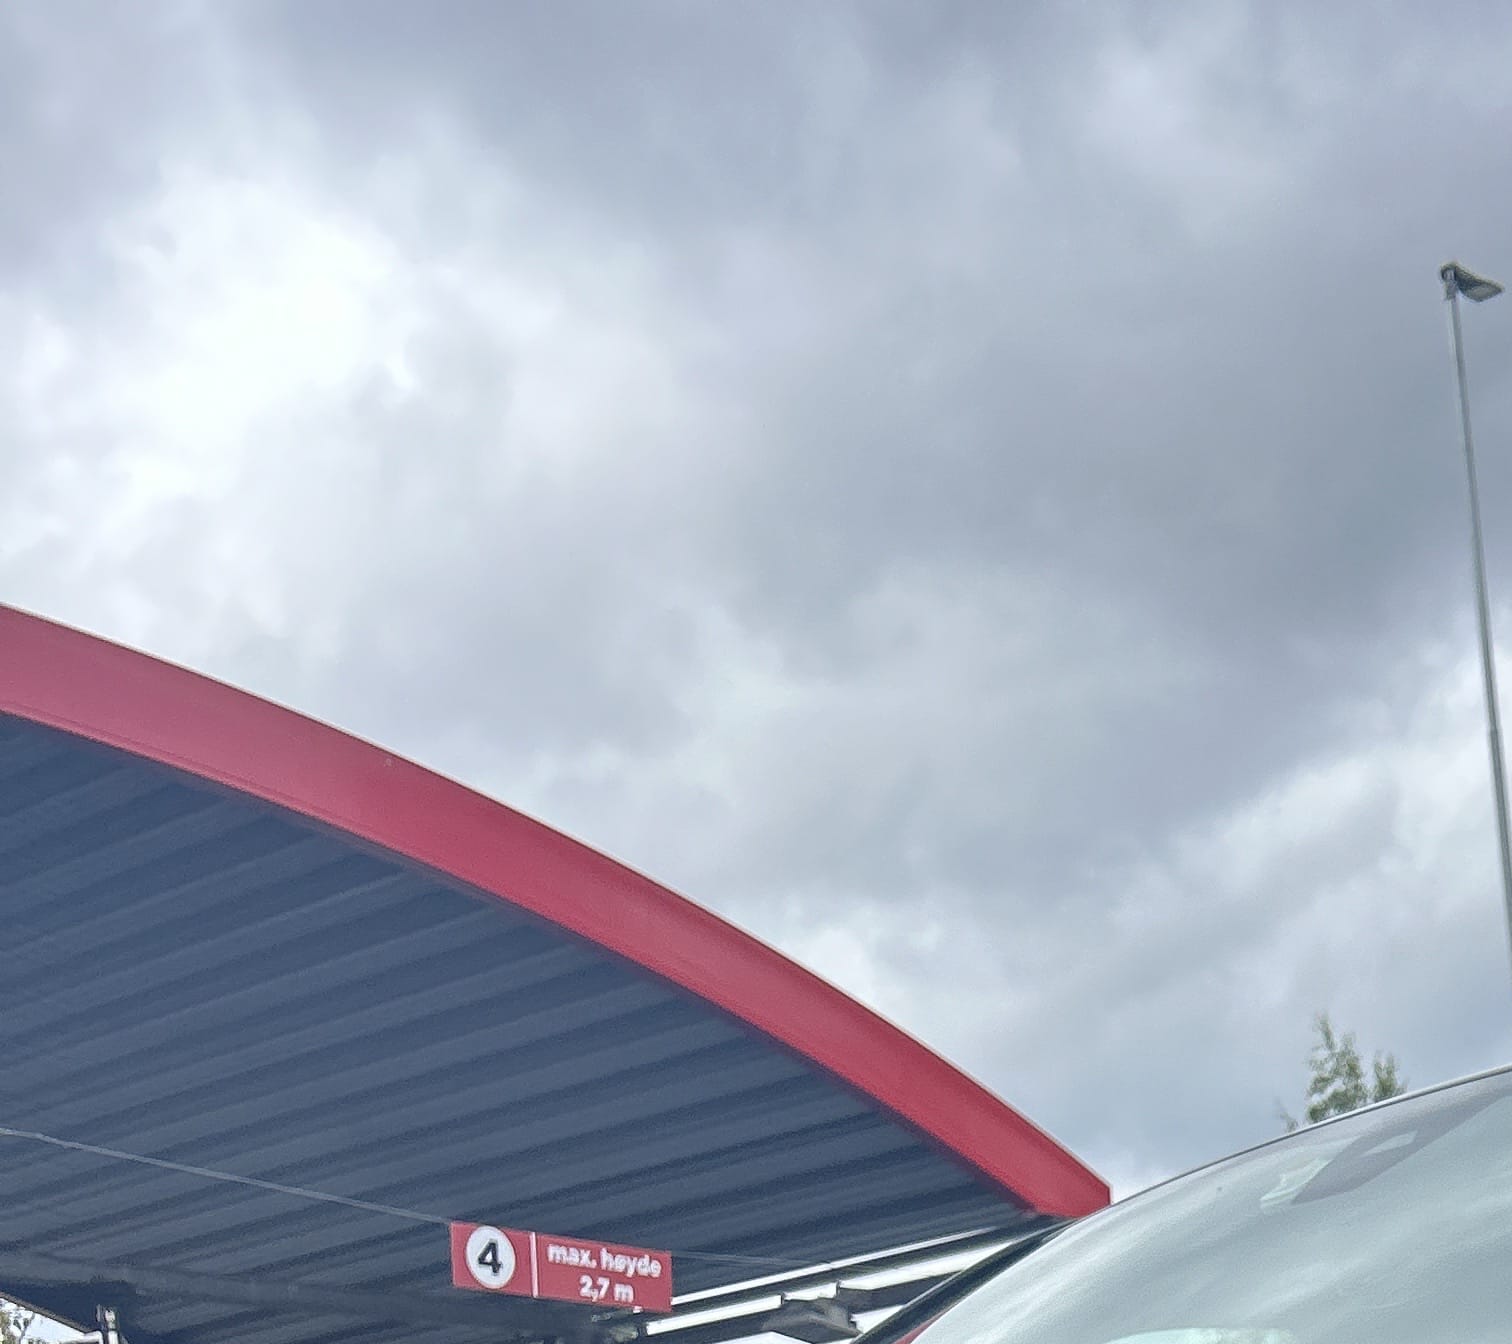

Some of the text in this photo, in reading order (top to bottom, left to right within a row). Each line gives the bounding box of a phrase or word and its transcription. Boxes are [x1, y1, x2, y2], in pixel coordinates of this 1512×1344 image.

[478, 1239, 501, 1275] 4
[547, 1243, 661, 1278] max. høyde
[579, 1275, 634, 1302] 2,7 m
